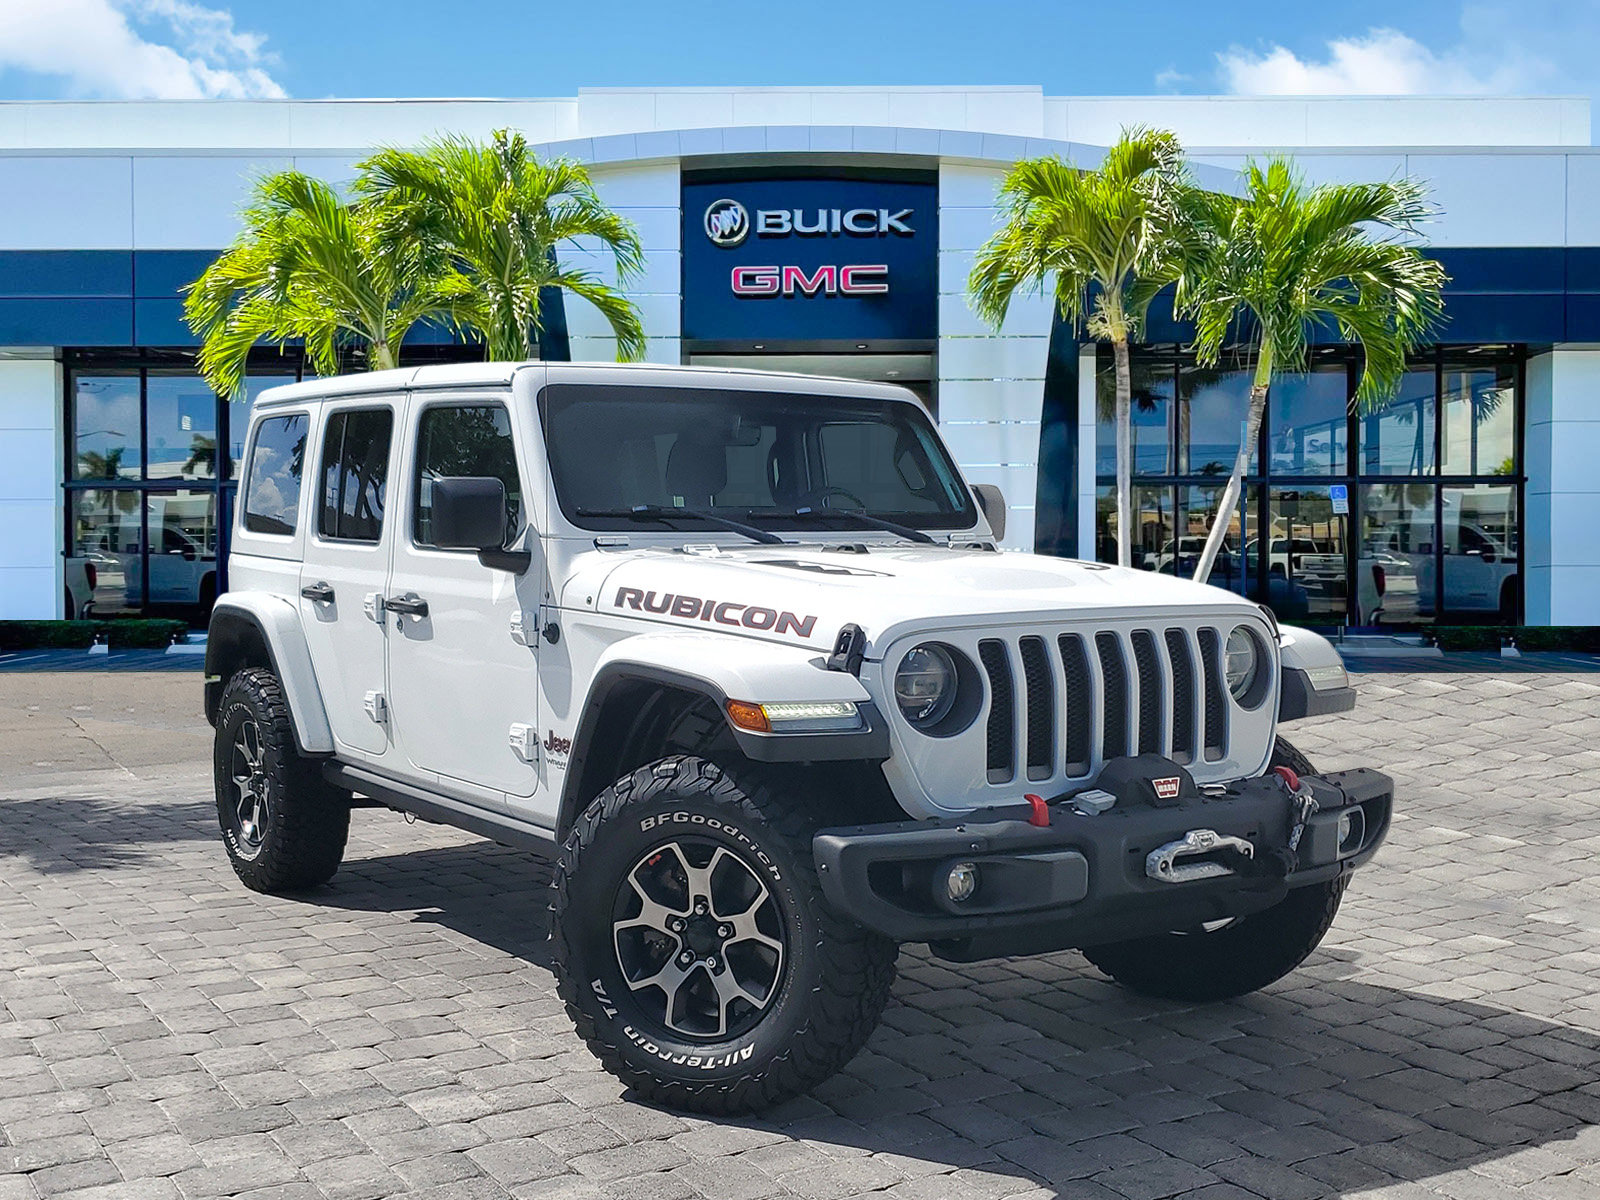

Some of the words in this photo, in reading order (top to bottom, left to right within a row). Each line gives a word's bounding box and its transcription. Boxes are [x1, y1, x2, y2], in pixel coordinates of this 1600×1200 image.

[757, 208, 916, 233] BUICK
[731, 264, 889, 293] GMC
[614, 586, 818, 638] RUBICON
[543, 729, 572, 755] Jee
[640, 811, 782, 881] BFGoodrich
[591, 979, 618, 1019] T/A
[623, 1025, 755, 1071] All-Terrain
